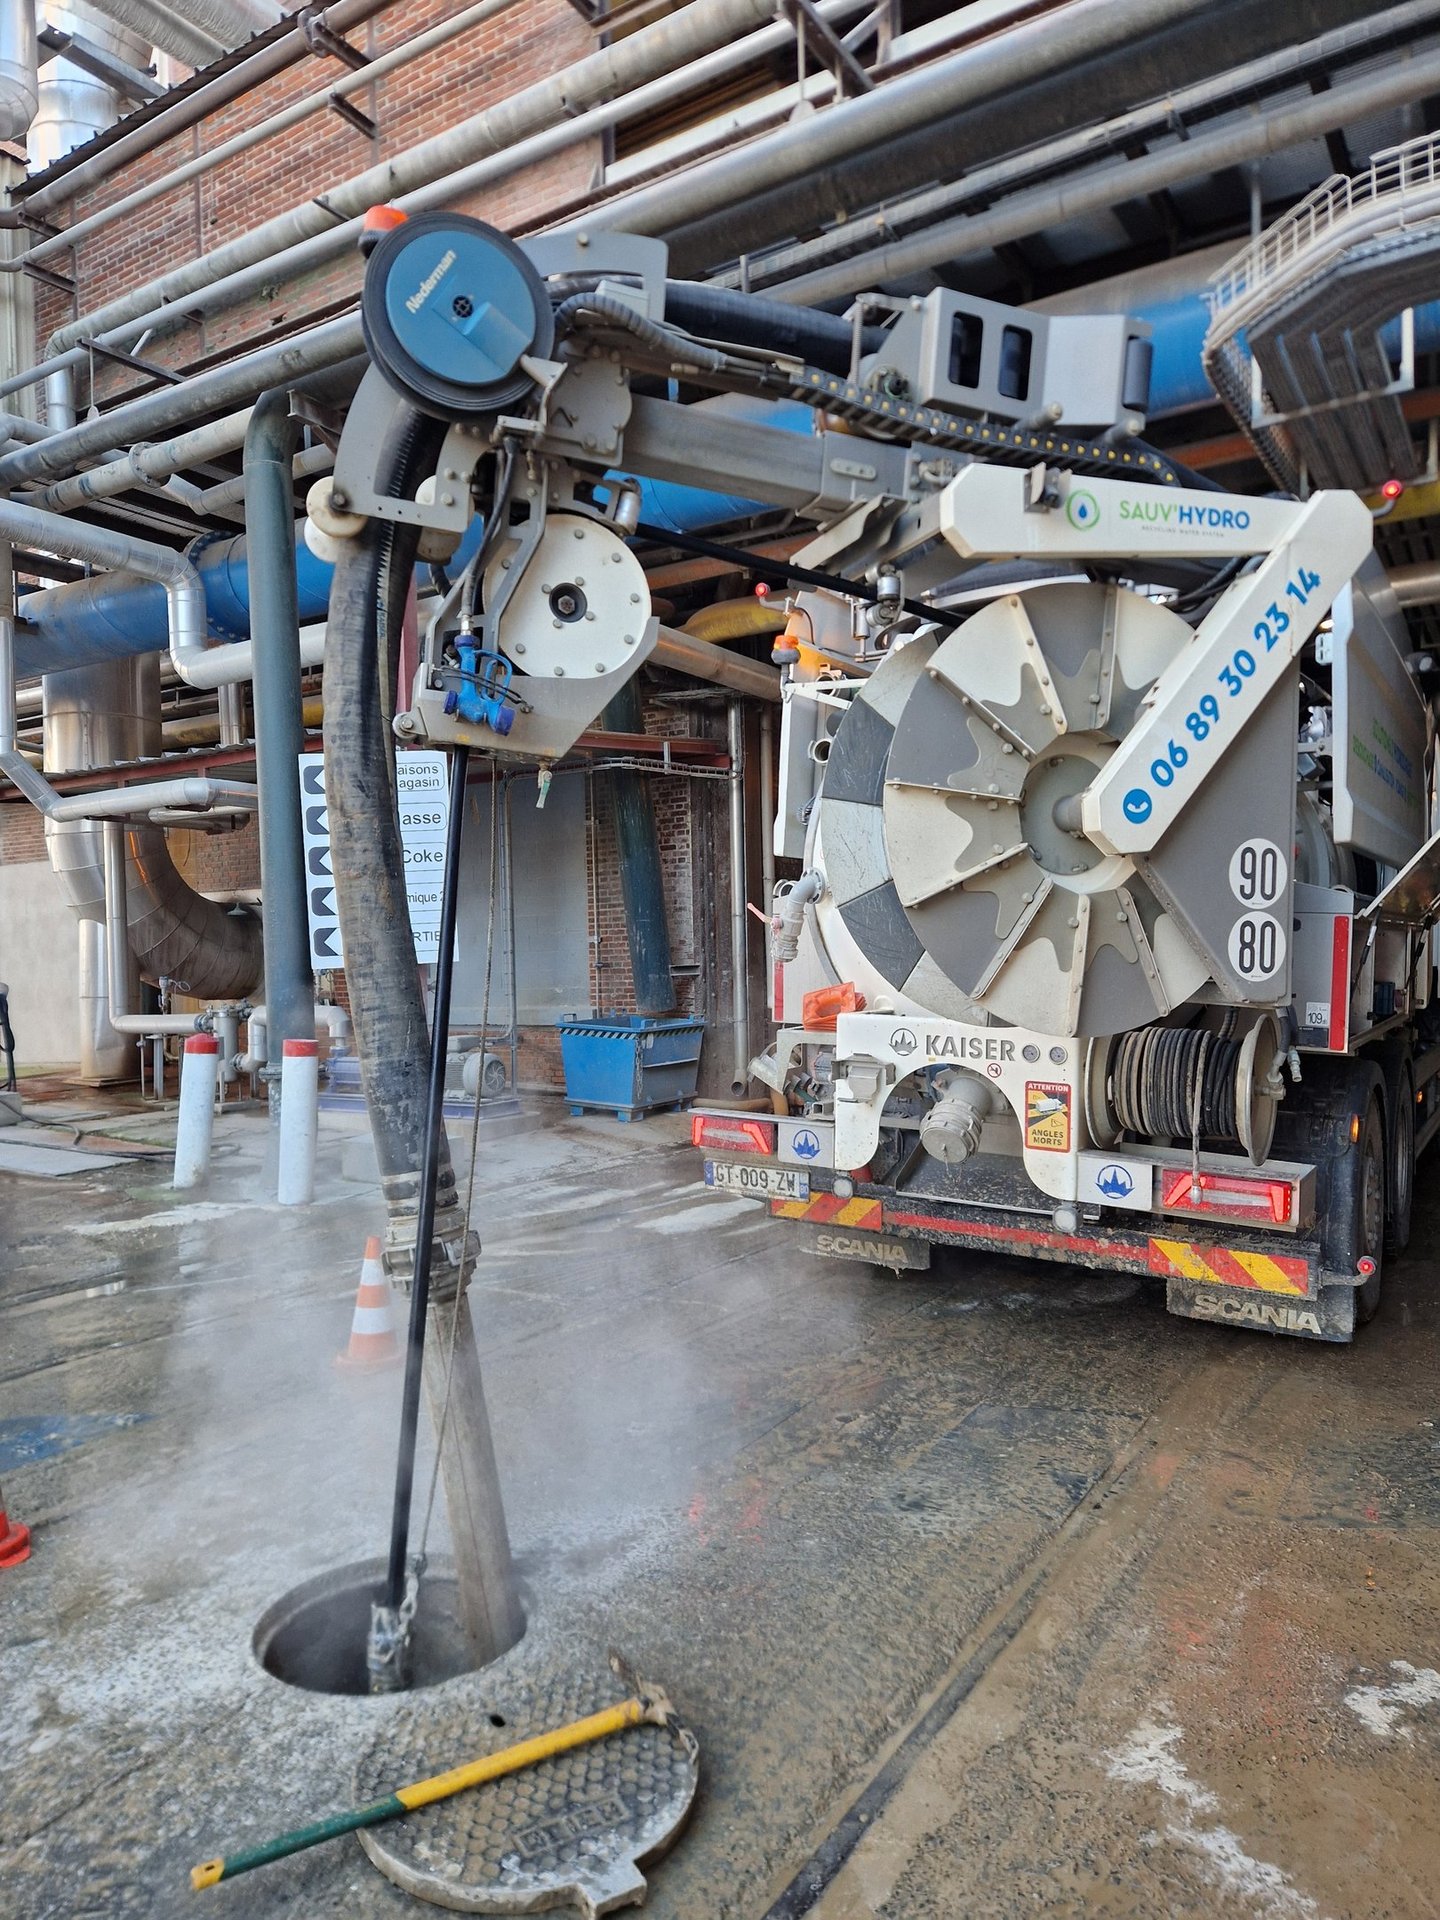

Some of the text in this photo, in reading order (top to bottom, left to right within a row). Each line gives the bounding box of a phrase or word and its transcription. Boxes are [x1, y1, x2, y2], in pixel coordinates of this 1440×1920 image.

[405, 249, 456, 314] Nederman
[1119, 501, 1250, 529] SAUV'HYDRO
[1150, 567, 1321, 787] 06 89 30 23 14
[397, 764, 439, 775] aisons
[399, 777, 440, 790] agasin
[402, 813, 441, 825] asse
[402, 849, 443, 863] Coke
[1239, 846, 1277, 901] 90
[406, 892, 437, 905] mique
[413, 930, 440, 942] RTIE
[1239, 920, 1276, 974] 80
[1308, 1012, 1322, 1024] 109
[926, 1034, 1015, 1062] KAISER
[1028, 1083, 1069, 1092] ATTENTION
[1032, 1129, 1064, 1138] ANGLES
[1033, 1137, 1062, 1145] MORTS
[816, 1234, 908, 1264] SCANIA
[1194, 1294, 1322, 1335] SCANIA
